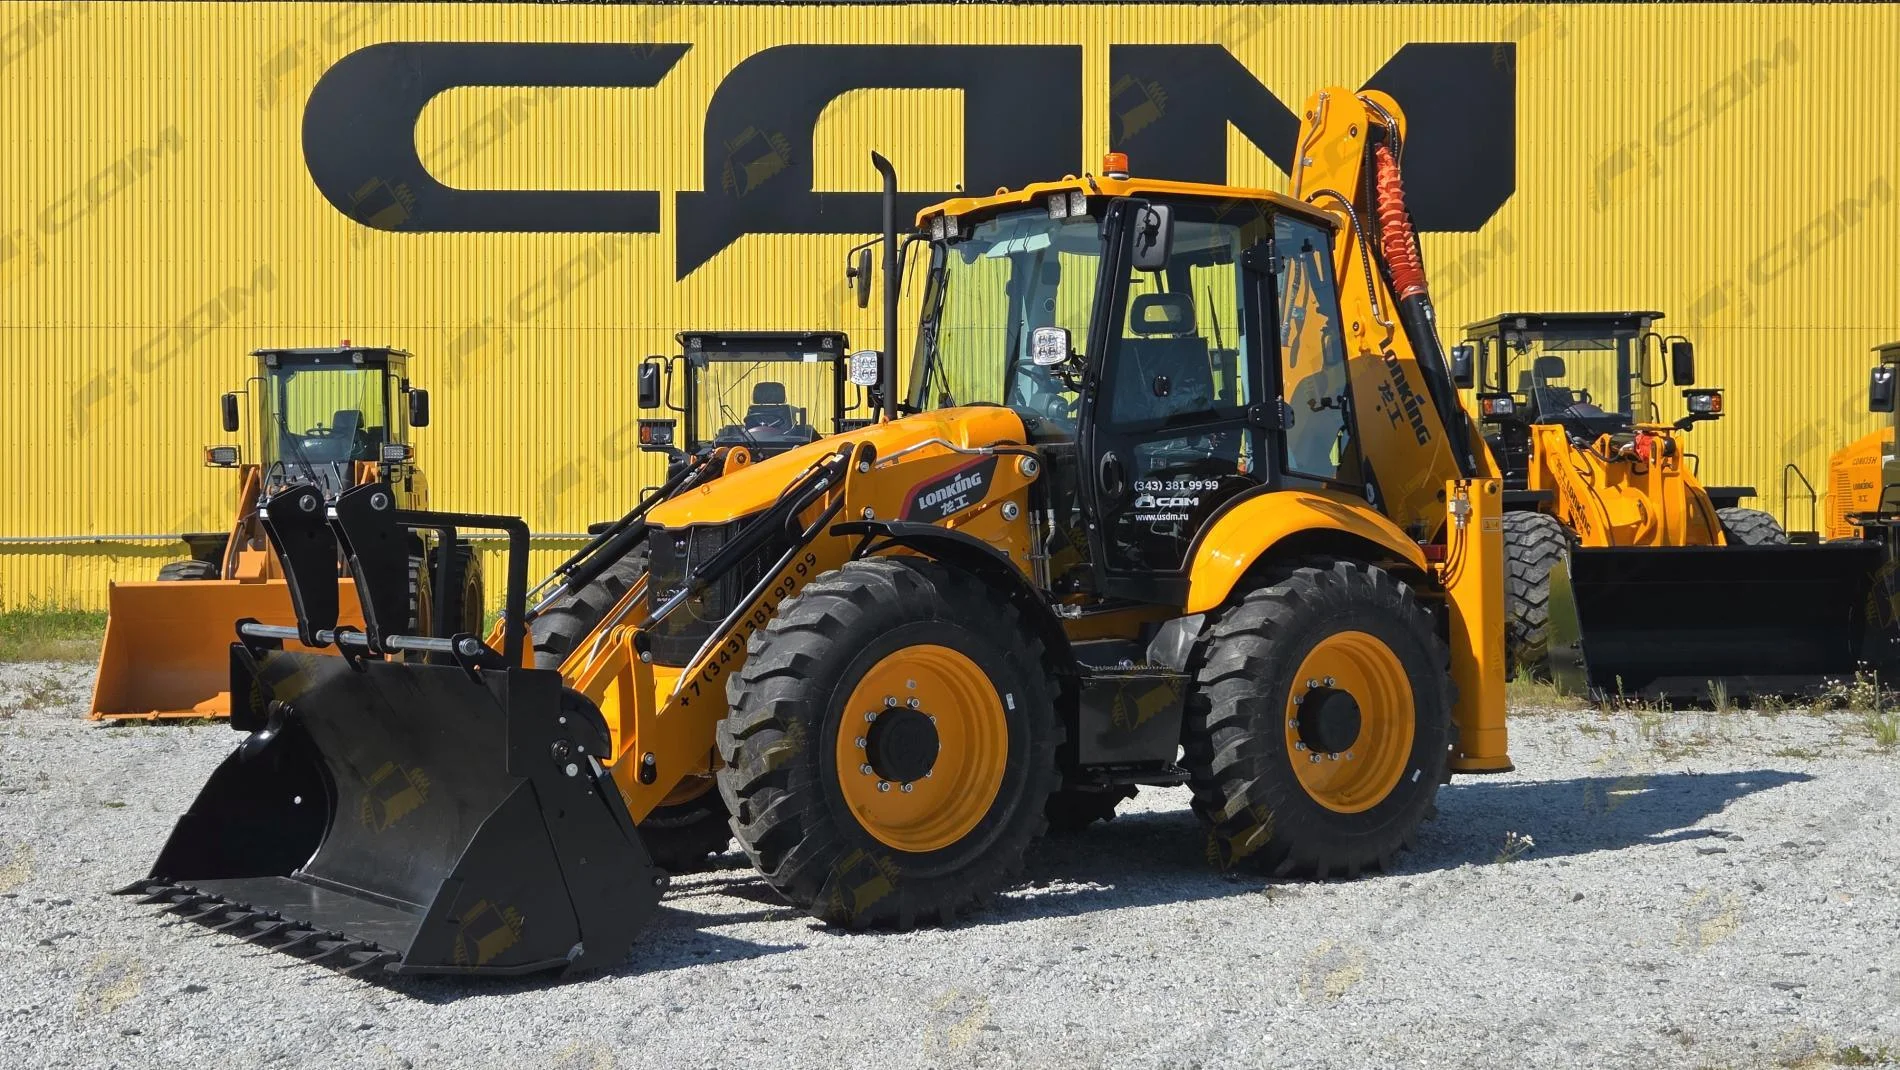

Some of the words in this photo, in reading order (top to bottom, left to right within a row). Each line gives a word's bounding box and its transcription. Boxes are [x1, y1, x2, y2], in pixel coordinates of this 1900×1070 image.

[1134, 480, 1163, 492] (343)
[1165, 480, 1186, 490] 381
[1188, 480, 1203, 490] 99
[1205, 480, 1219, 490] 99
[1135, 512, 1189, 521] www.usdm.ru
[702, 633, 746, 682] (343)
[745, 601, 775, 634] 381
[774, 576, 796, 601] 99
[795, 552, 817, 577] 99
